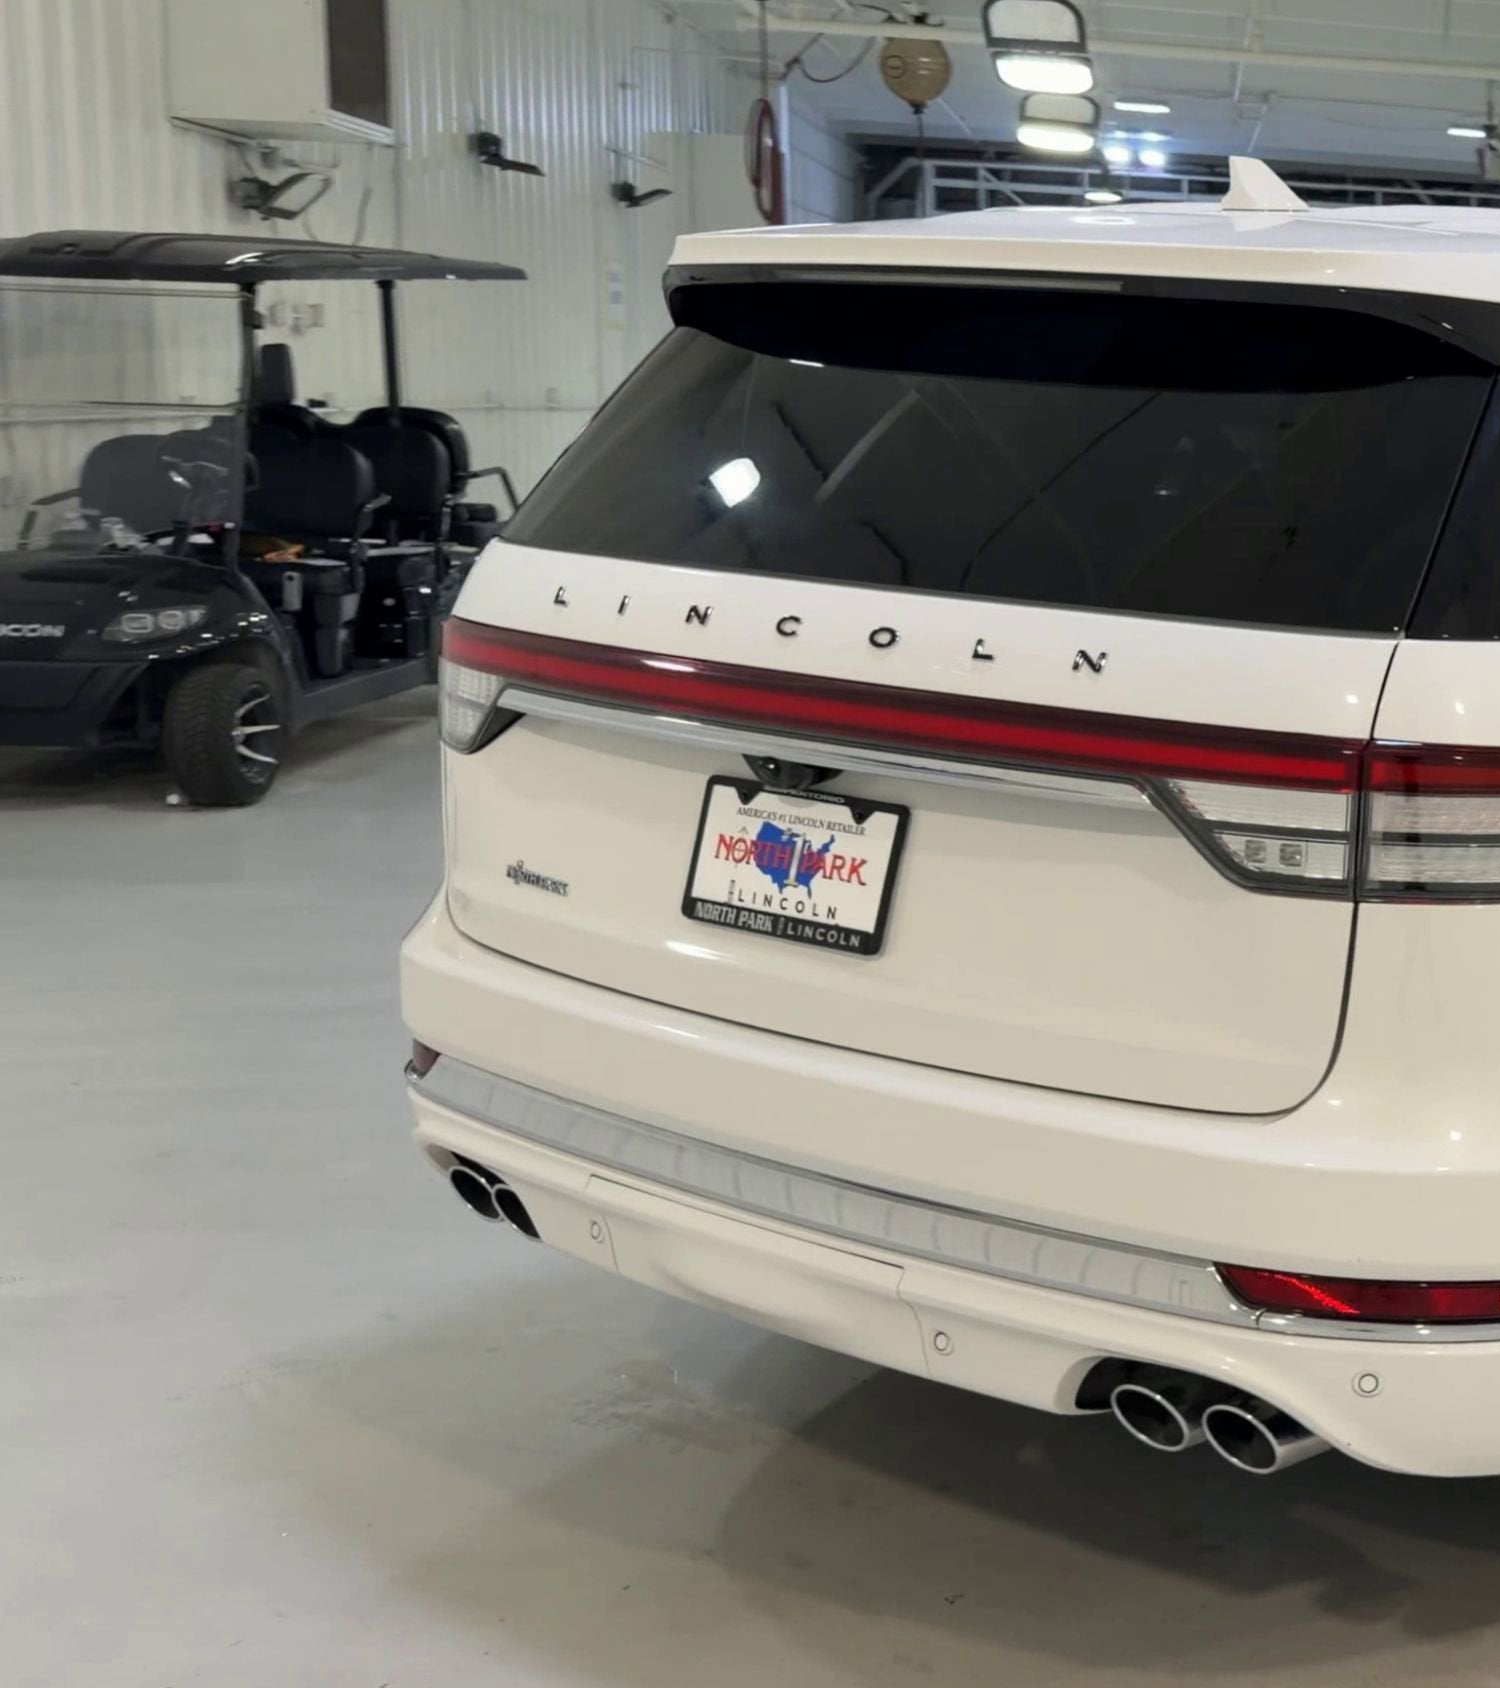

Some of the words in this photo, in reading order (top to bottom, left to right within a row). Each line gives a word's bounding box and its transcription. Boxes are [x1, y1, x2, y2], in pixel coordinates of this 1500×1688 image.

[553, 586, 1109, 675] LINCOLN
[788, 813, 825, 830] LINCOLN
[826, 820, 867, 836] RETAILER
[714, 833, 793, 870] NORTH
[800, 849, 867, 886] PARK
[694, 901, 737, 926] NORTH
[738, 910, 774, 933] PARK
[786, 921, 861, 947] LINCOLN
[738, 888, 837, 920] LINCOLN
